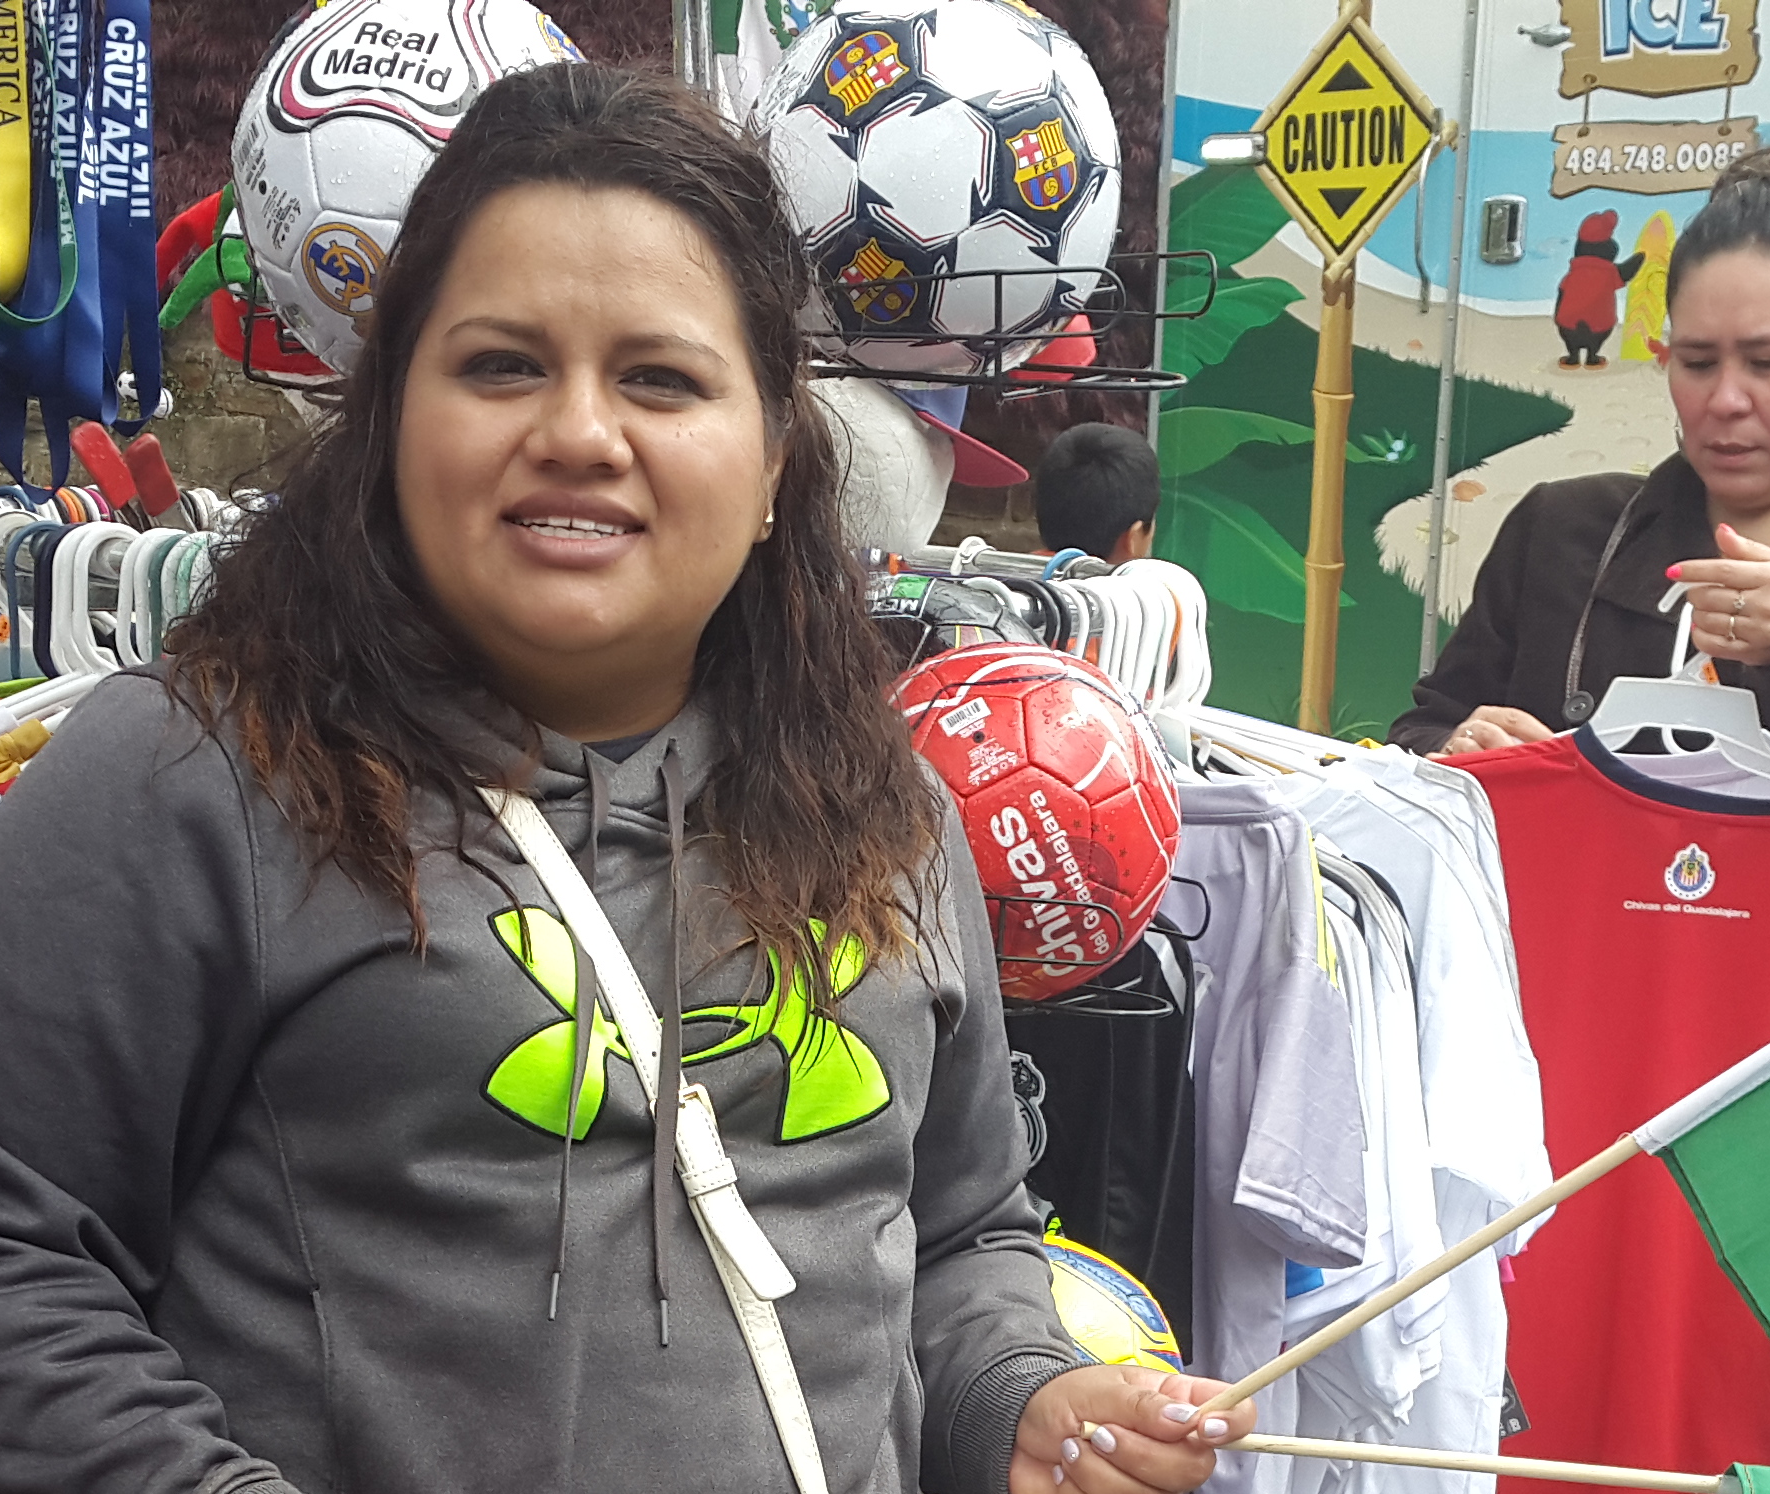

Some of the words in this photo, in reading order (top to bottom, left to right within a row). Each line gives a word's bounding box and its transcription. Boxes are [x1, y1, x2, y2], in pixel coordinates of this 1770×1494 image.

[101, 18, 137, 111] CRUZ
[323, 48, 453, 94] Madrid
[354, 21, 440, 55] Real
[99, 116, 131, 207] AZUL
[1283, 104, 1406, 174] CAUTION
[990, 806, 1085, 977] Chivas
[1089, 929, 1111, 955] del
